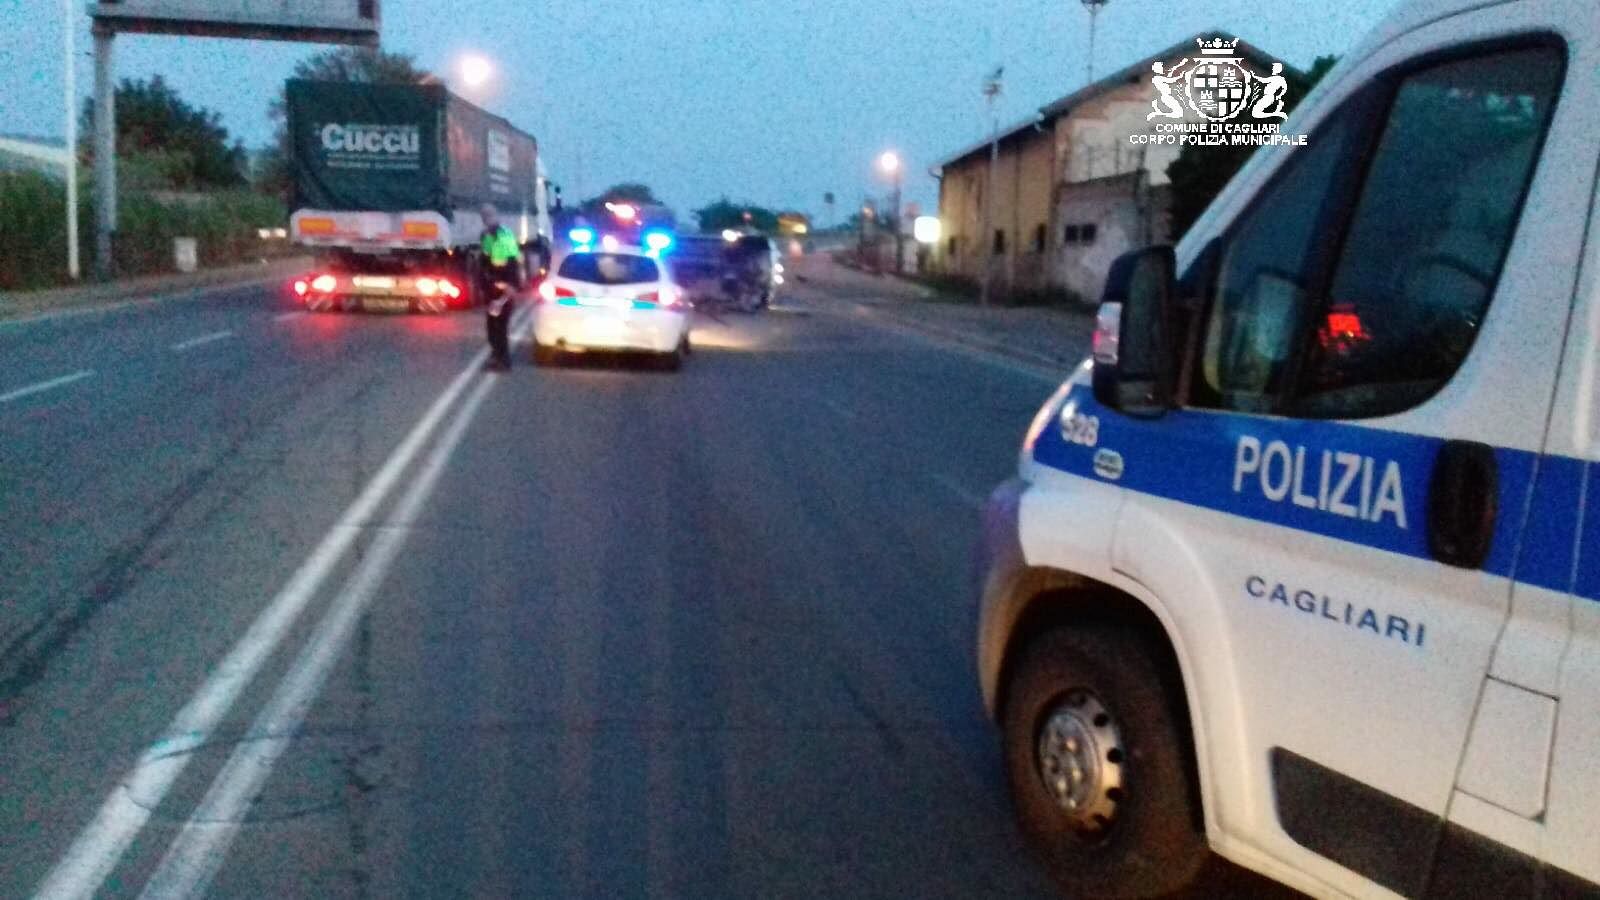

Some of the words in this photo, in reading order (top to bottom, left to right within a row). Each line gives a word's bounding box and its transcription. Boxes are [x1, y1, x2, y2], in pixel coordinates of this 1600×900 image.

[321, 123, 419, 153] Cuccu
[1232, 434, 1408, 529] POLIZIA
[1245, 575, 1426, 646] CAGLIARI
